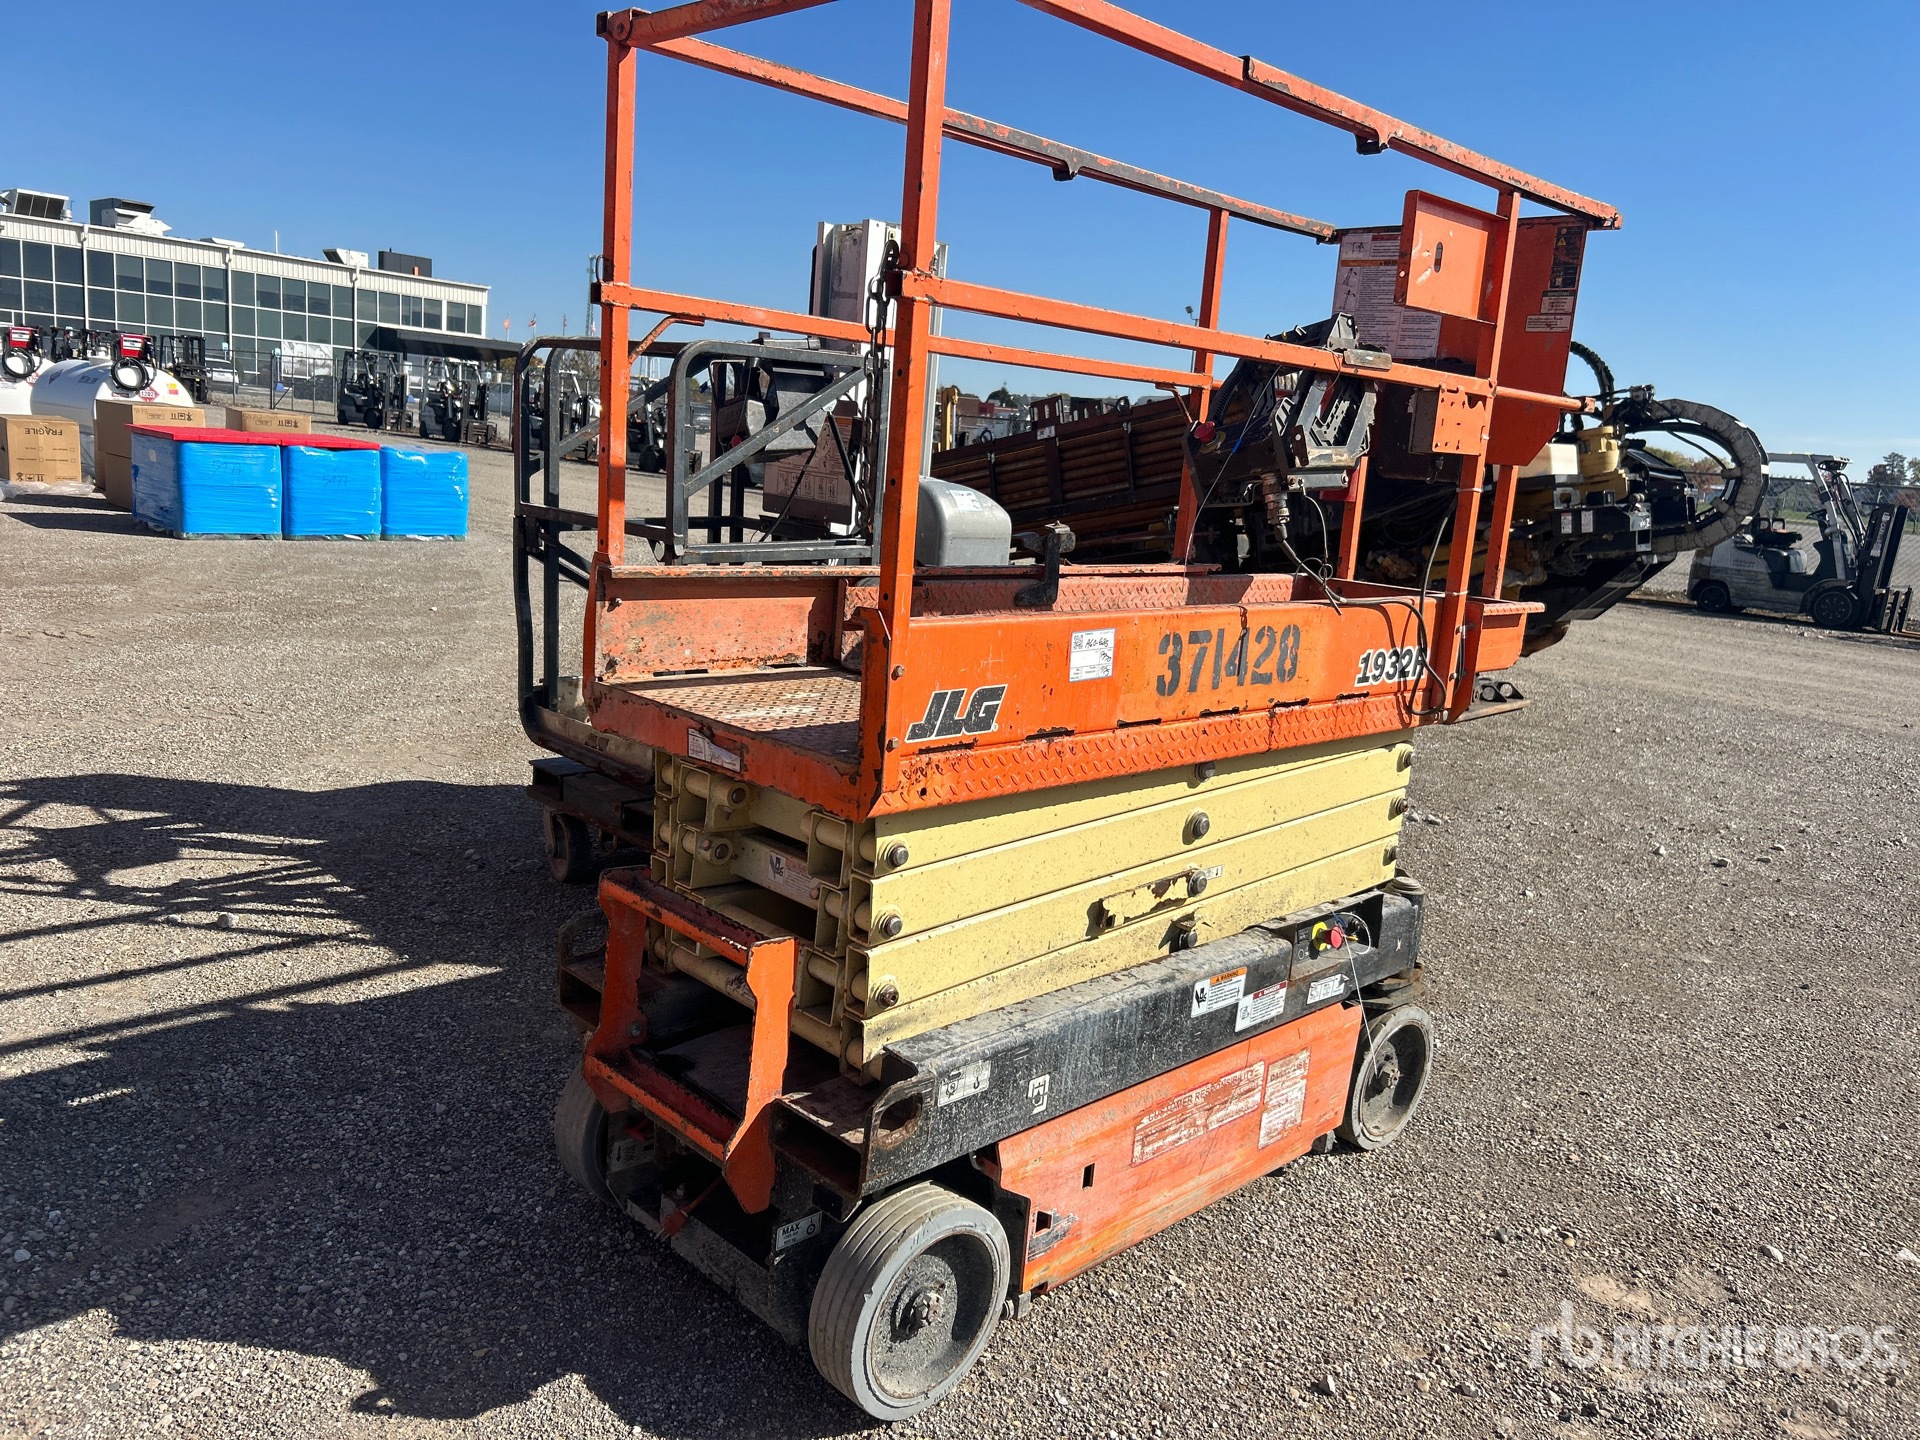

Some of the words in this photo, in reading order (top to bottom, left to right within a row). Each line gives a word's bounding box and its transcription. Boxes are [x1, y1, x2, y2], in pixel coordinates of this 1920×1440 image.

[24, 426, 63, 436] FRAGILE
[905, 685, 1007, 742] JLG
[1263, 984, 1280, 994] DANGER
[782, 1222, 800, 1236] MAX
